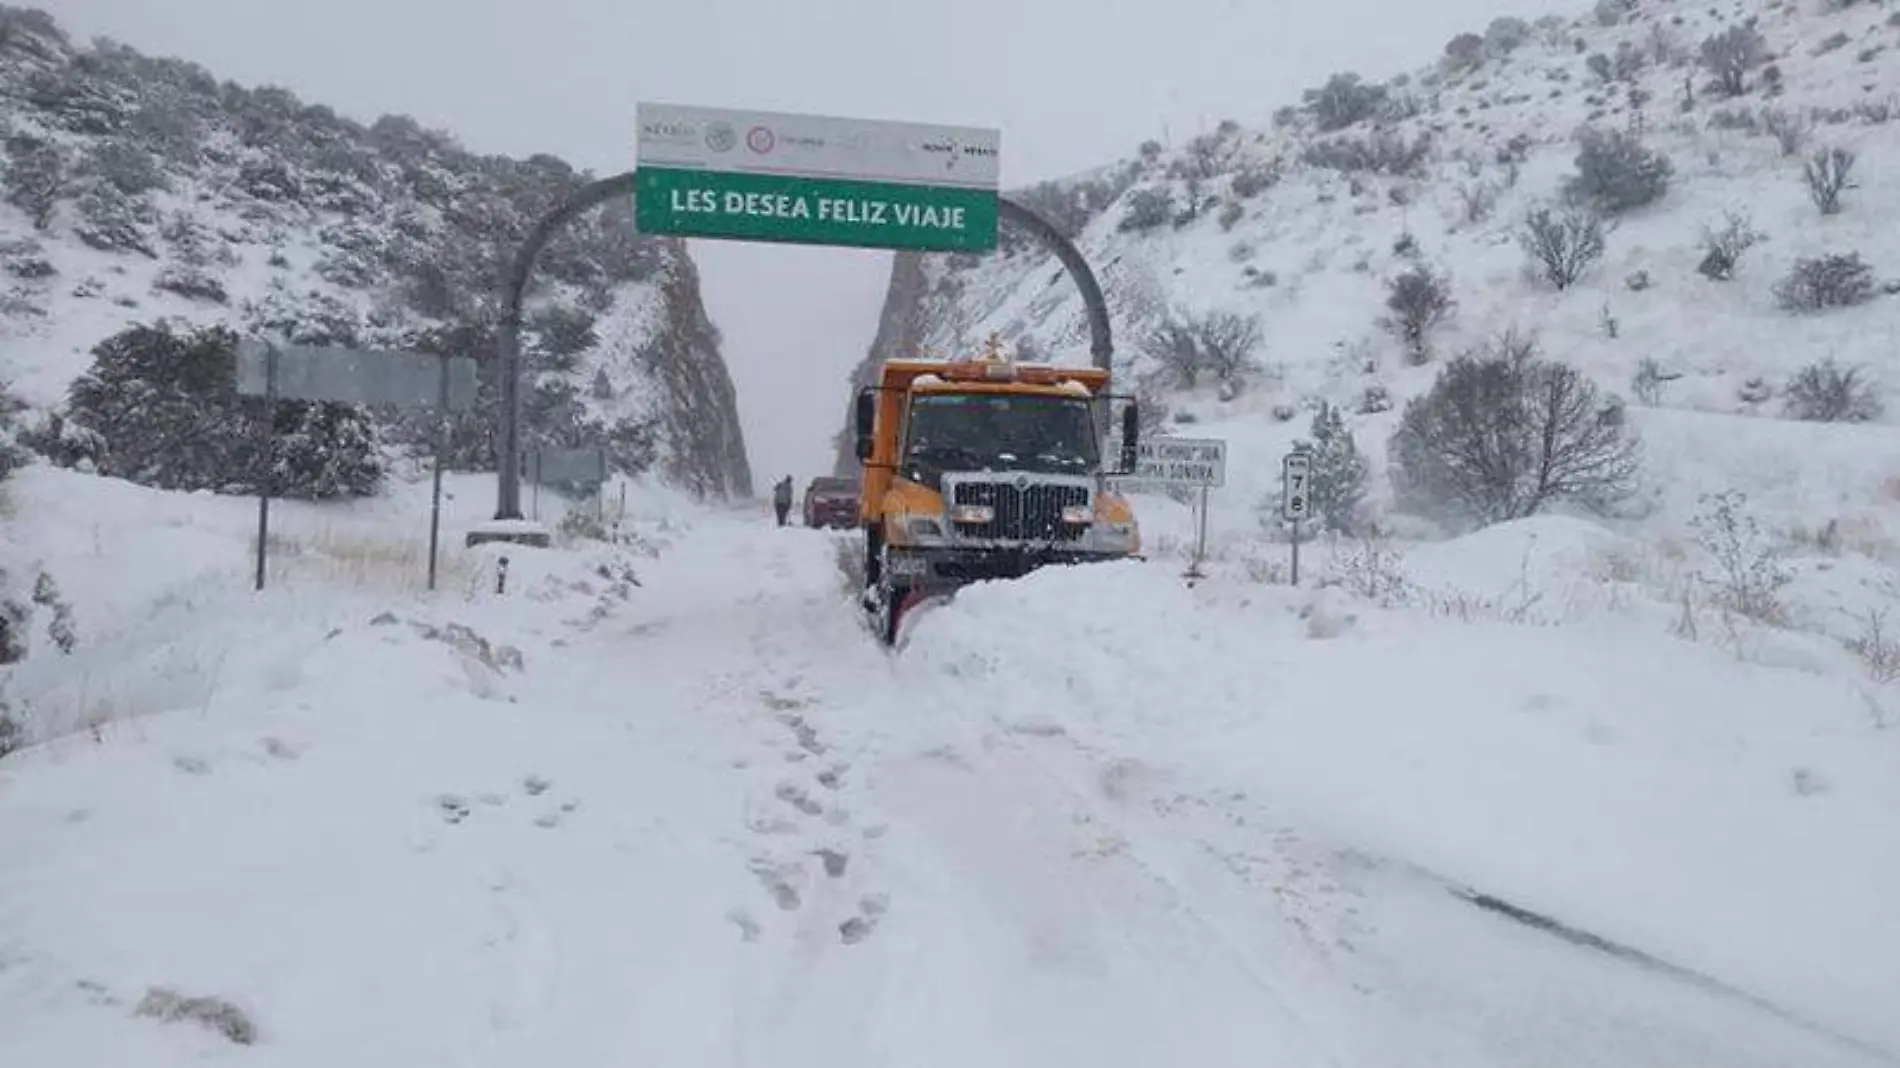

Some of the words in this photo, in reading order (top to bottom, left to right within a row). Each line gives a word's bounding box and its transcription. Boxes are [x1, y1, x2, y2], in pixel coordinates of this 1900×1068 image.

[671, 189, 715, 212] LES
[724, 192, 809, 219] DESEA
[818, 199, 886, 224] FELIZ
[894, 203, 965, 229] VIAJE
